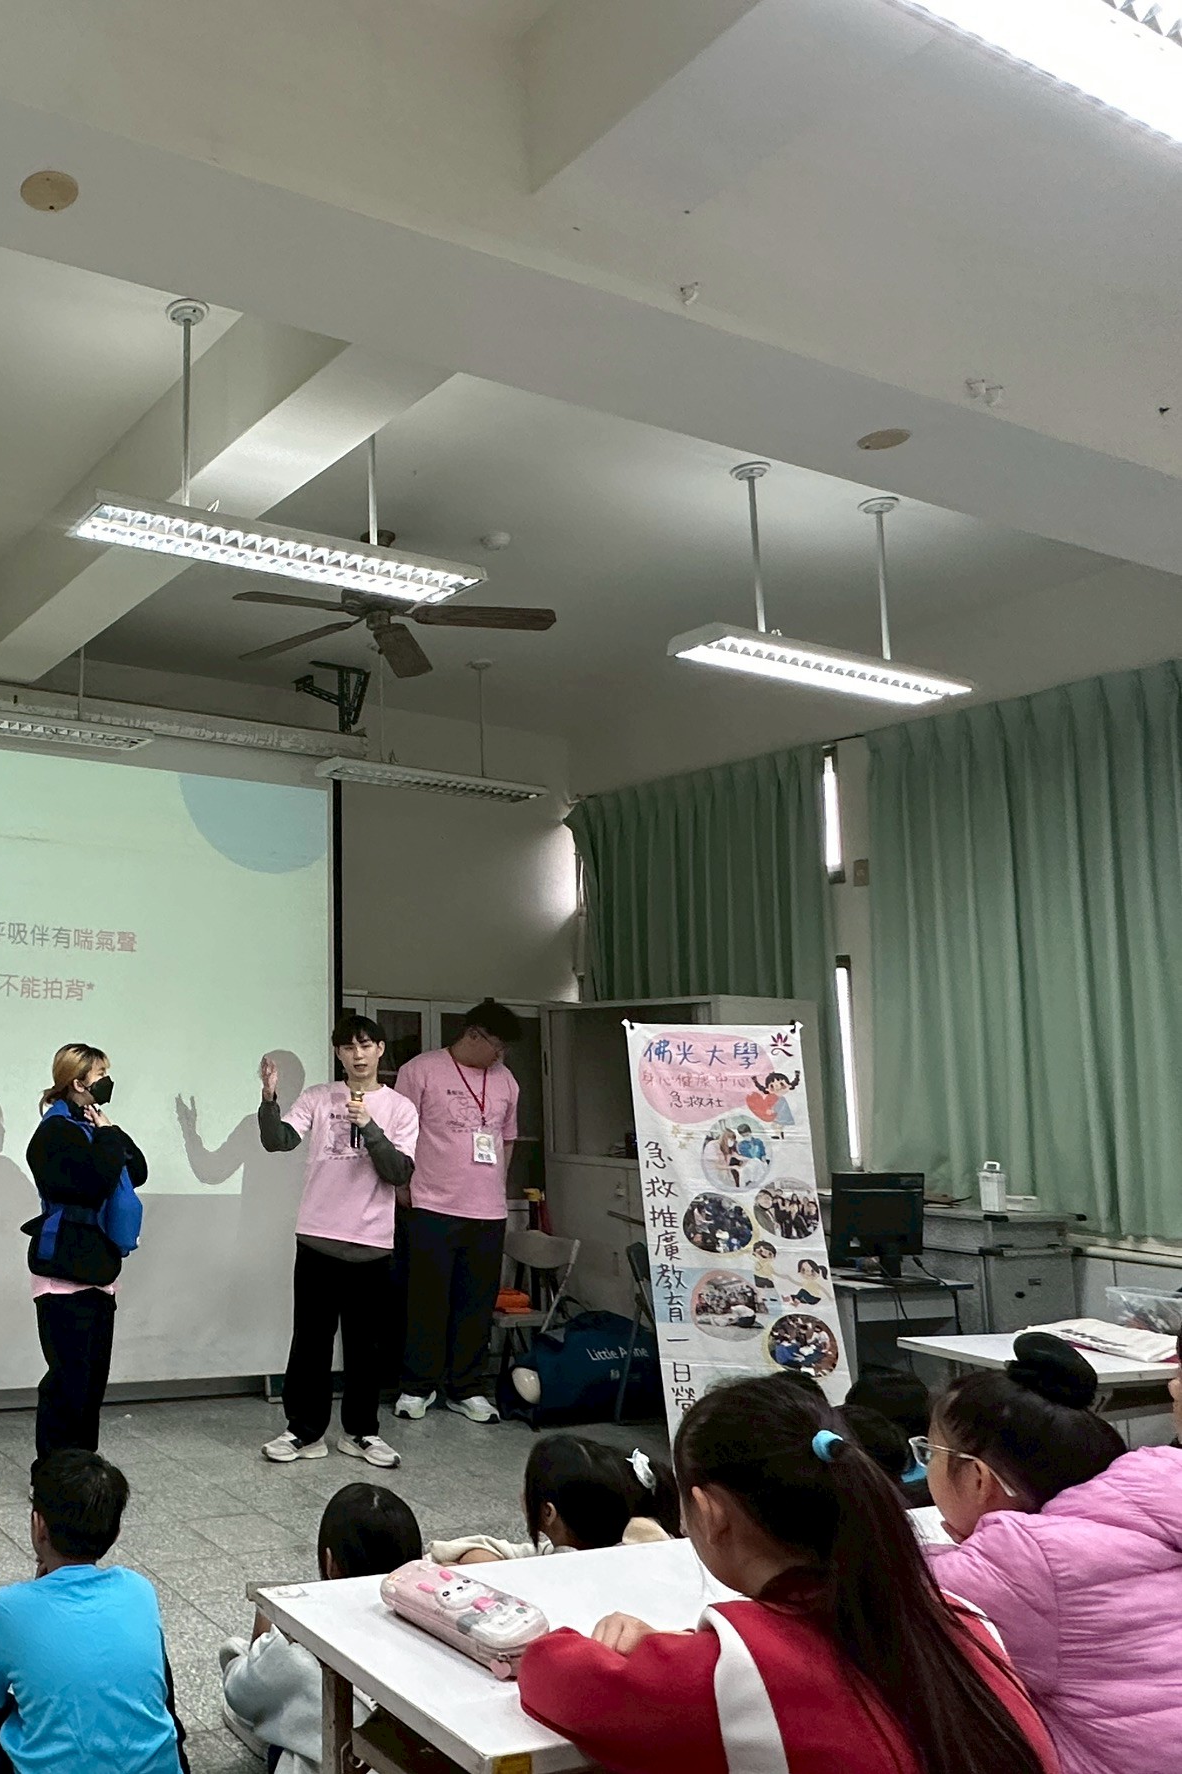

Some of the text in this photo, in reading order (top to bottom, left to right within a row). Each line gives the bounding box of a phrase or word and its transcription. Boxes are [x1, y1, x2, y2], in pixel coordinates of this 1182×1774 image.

[644, 1040, 758, 1069] 佛光大學
[670, 1090, 724, 1108] 急救社
[586, 1346, 649, 1361] Little Ane
